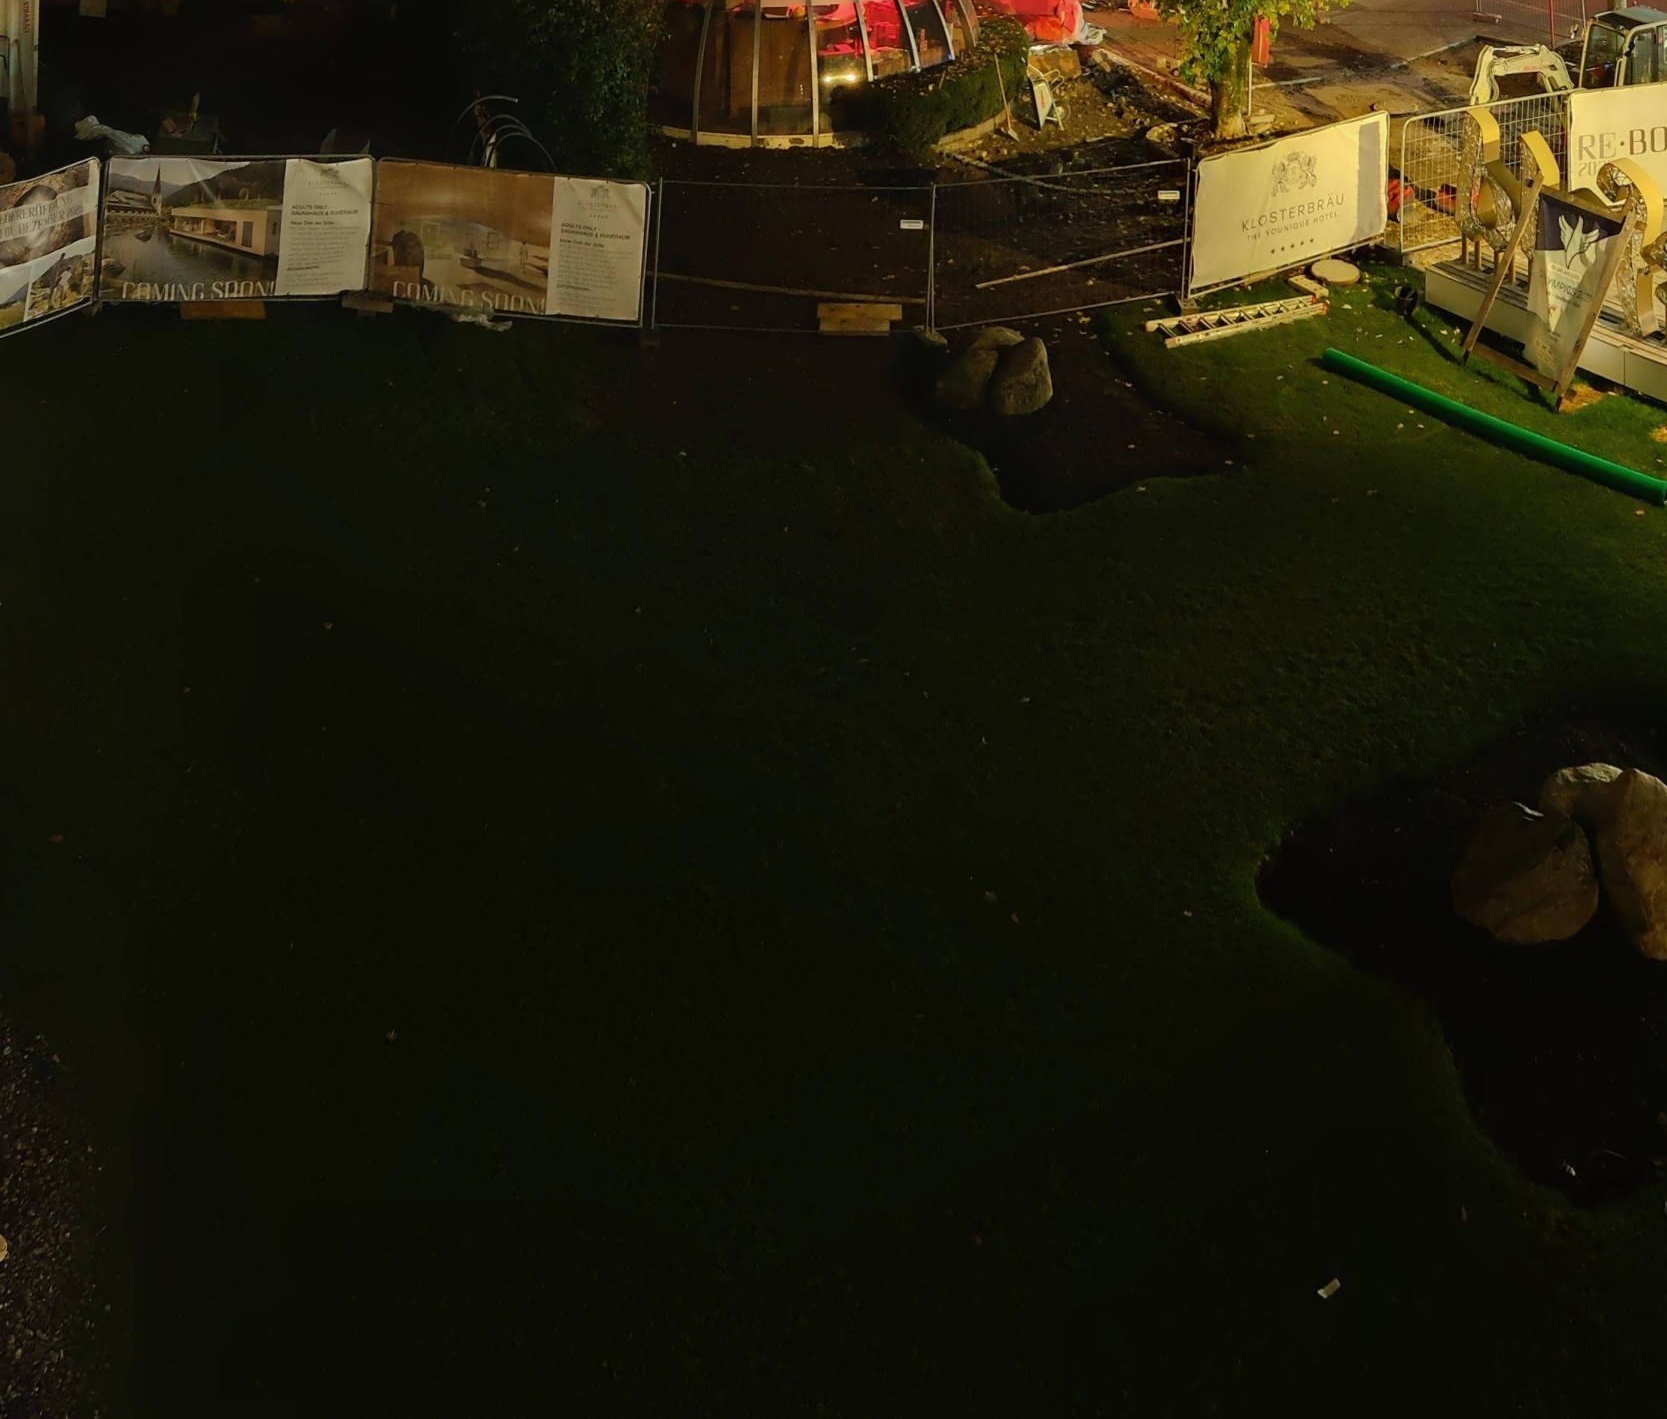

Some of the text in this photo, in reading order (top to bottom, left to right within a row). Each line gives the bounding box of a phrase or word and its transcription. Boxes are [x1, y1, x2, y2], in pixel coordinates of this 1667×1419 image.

[1241, 192, 1345, 232] KLOSTERBRÄU
[1246, 211, 1338, 242] THE YOUNIQUE HOTEL
